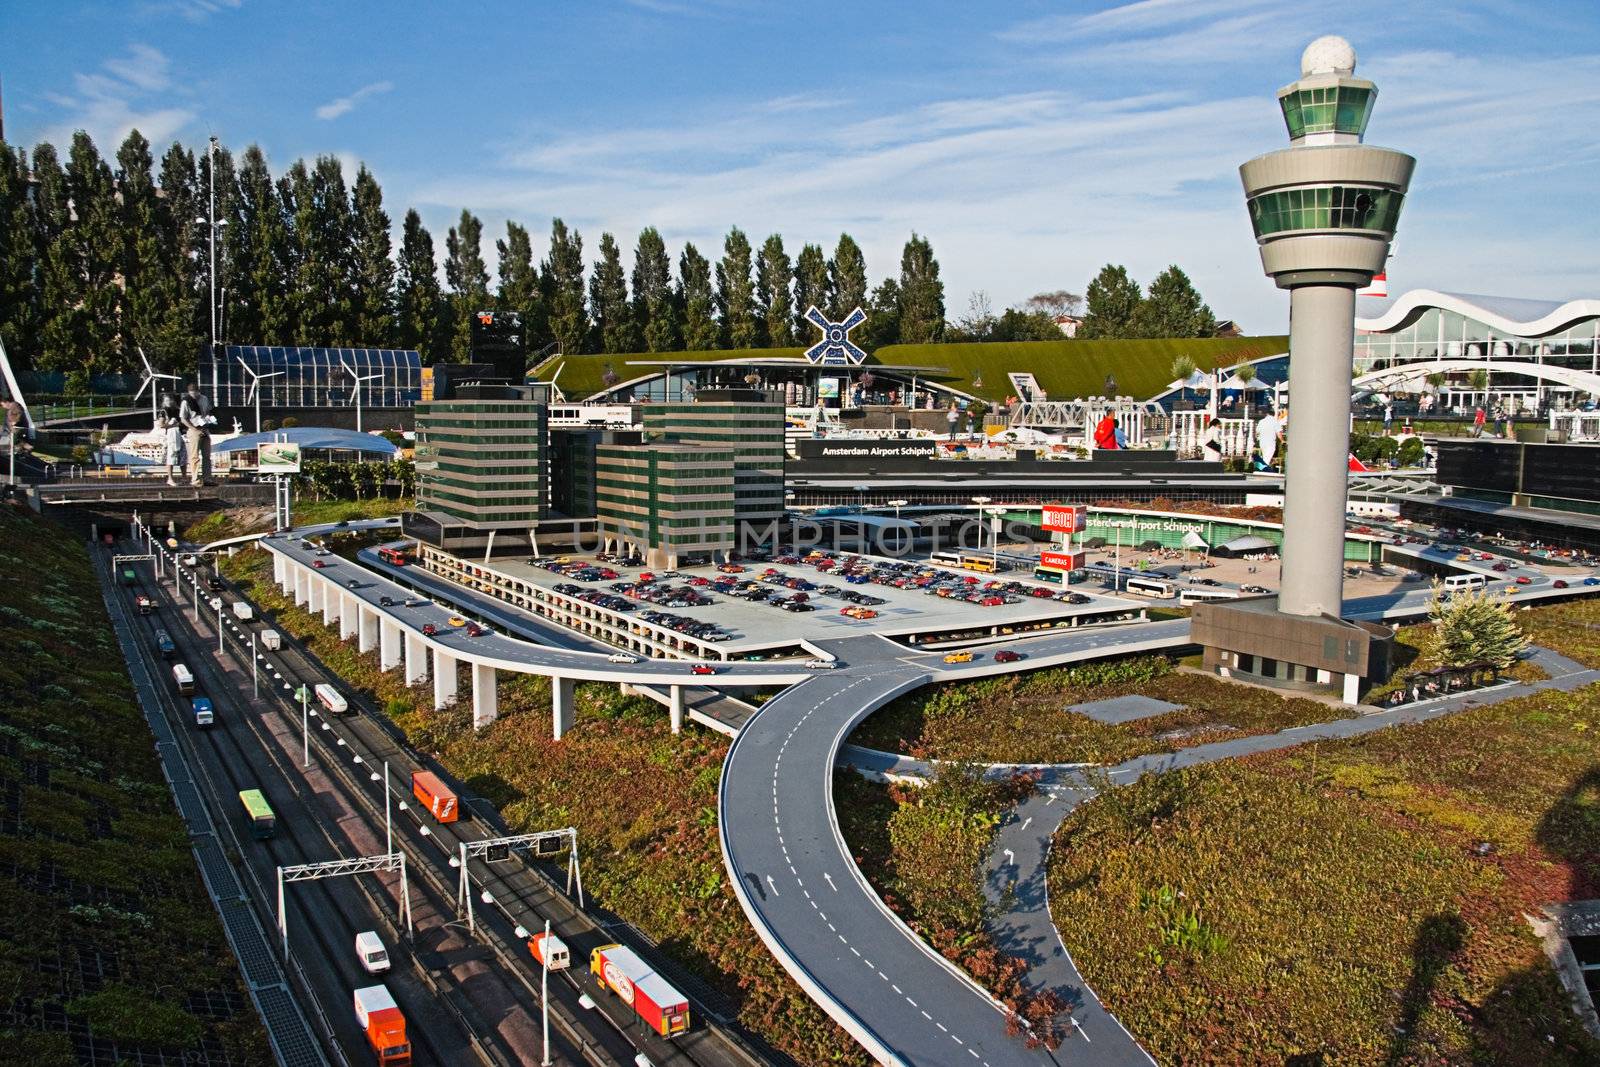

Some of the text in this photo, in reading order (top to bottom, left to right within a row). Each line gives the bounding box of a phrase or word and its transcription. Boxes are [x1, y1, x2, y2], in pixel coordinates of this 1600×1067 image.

[823, 447, 934, 457] Amsterdam Airport Schiphol
[1043, 510, 1072, 528] RICOH
[1128, 519, 1160, 531] Airport
[1163, 521, 1204, 533] Schiphol
[1044, 556, 1068, 566] CAMERAS
